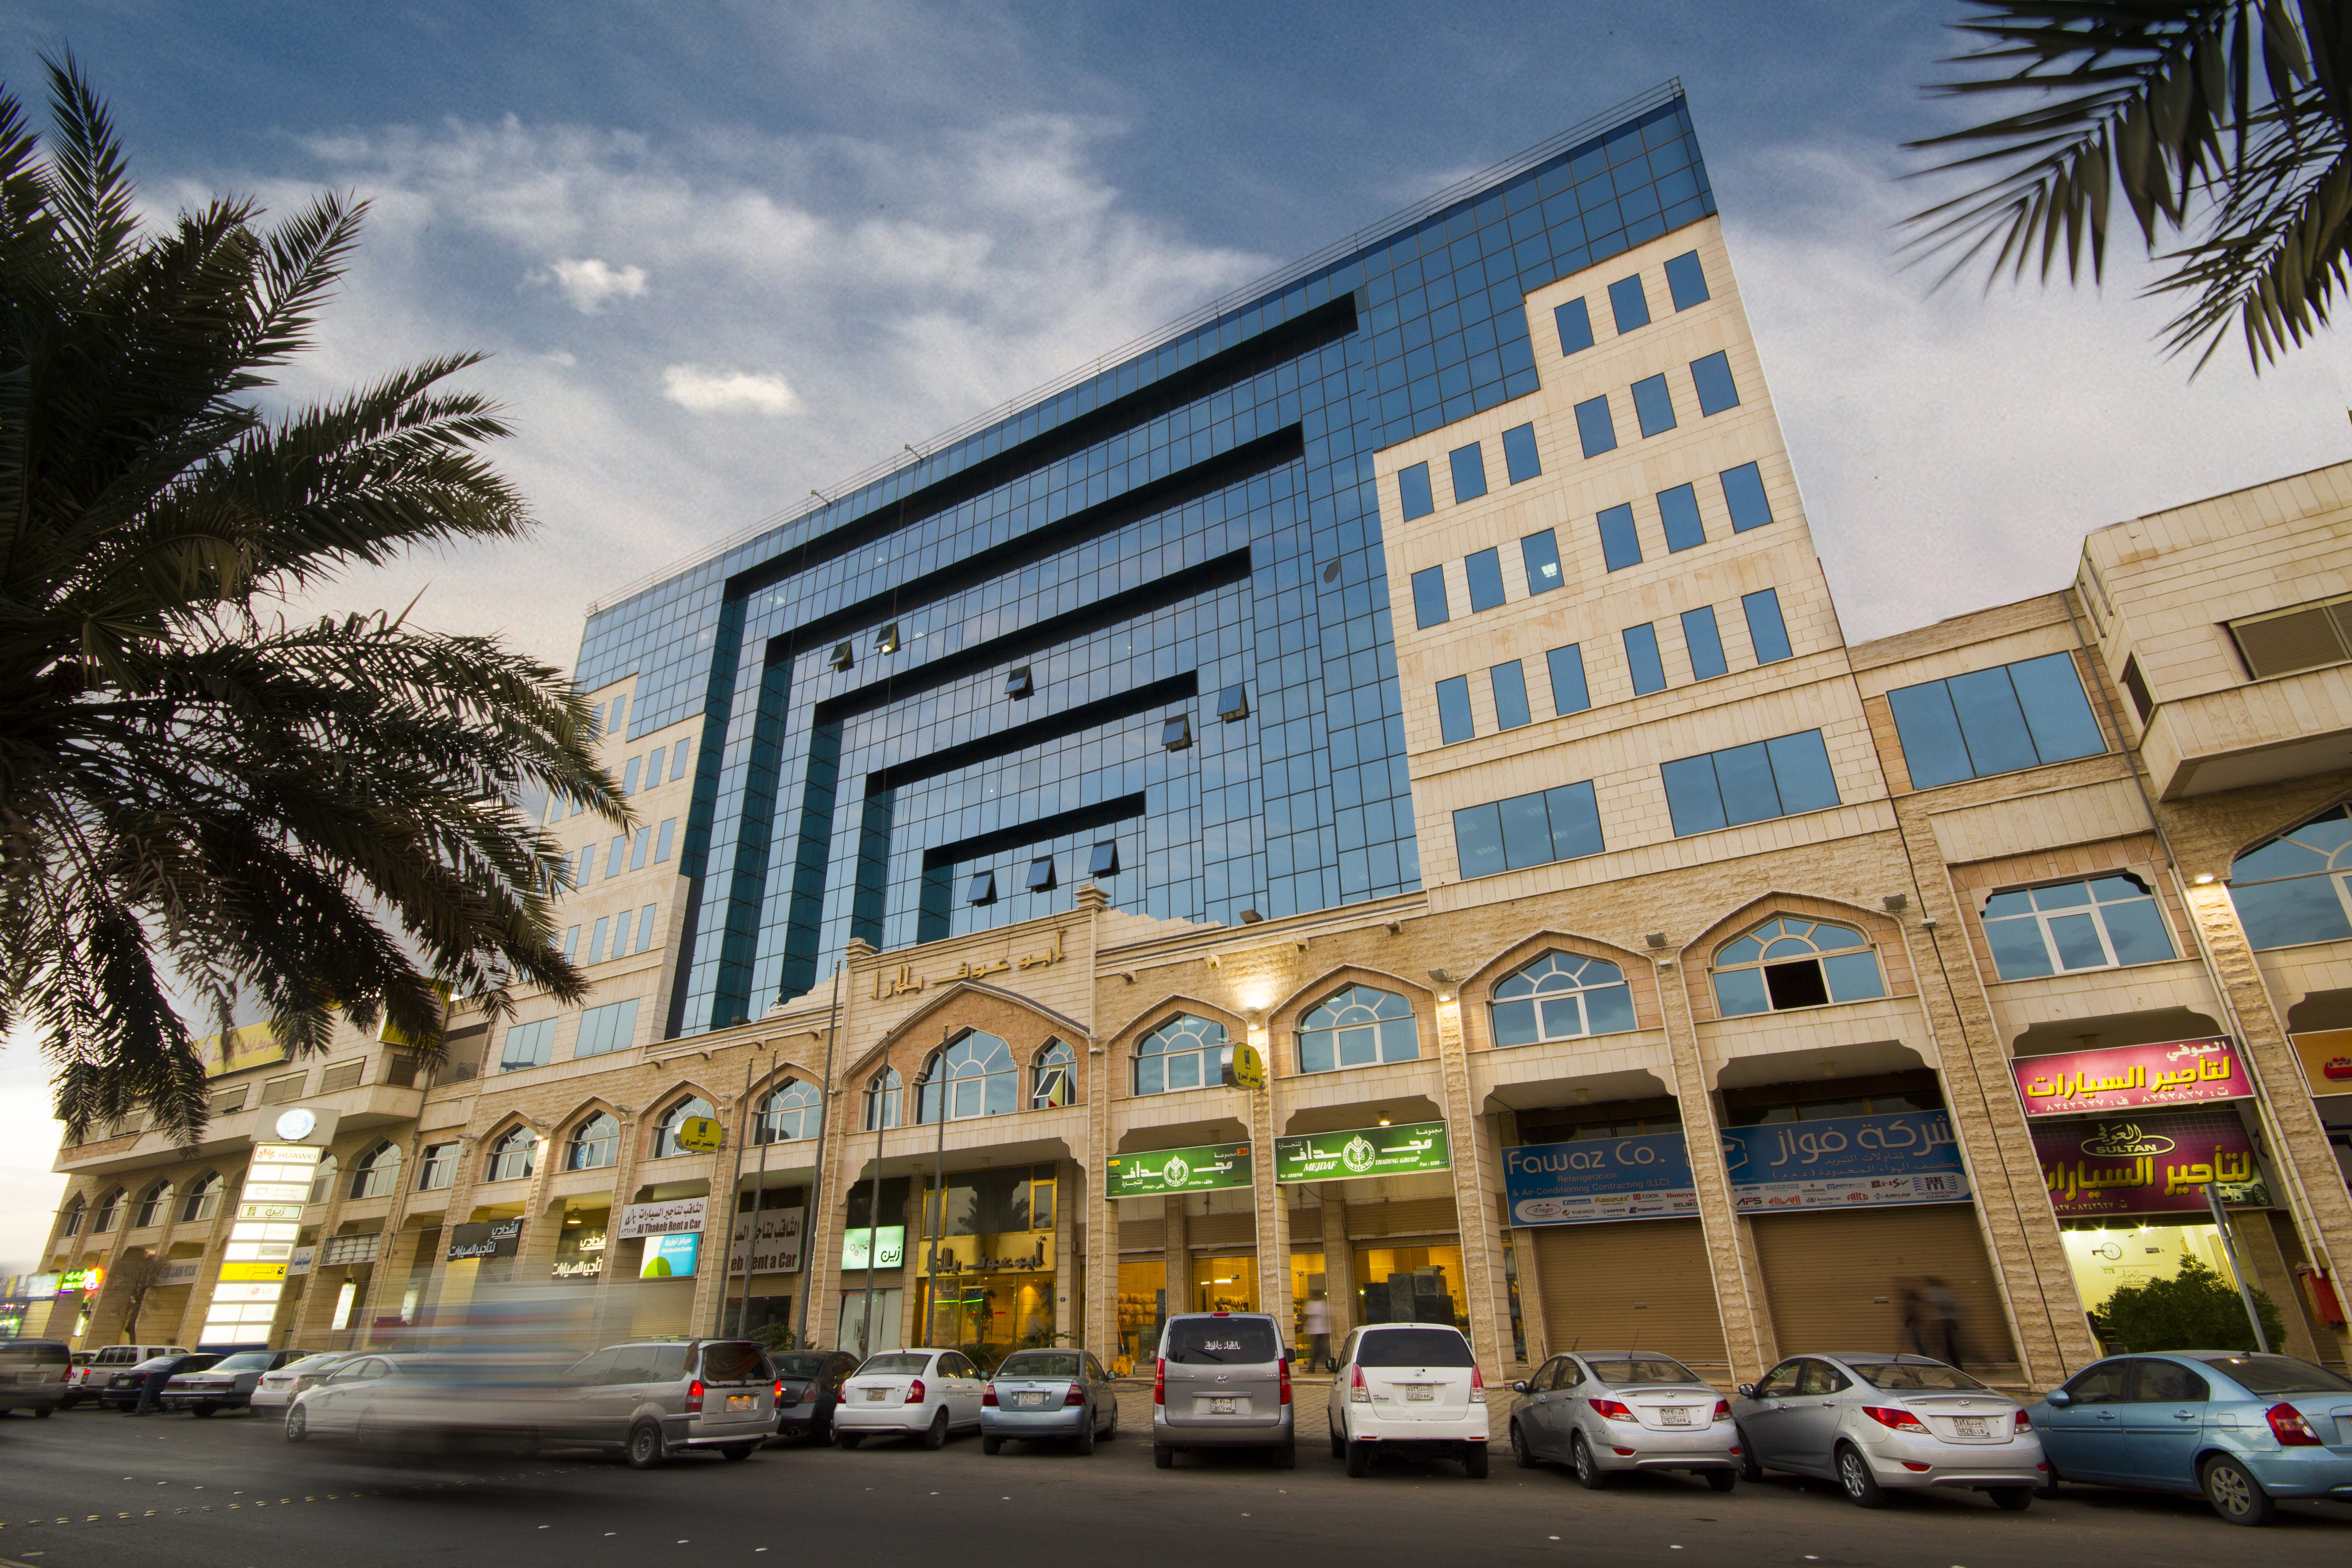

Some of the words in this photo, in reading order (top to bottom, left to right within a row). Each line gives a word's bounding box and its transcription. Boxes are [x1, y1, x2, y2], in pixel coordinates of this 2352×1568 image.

[1018, 926, 1066, 969] أبو
[868, 964, 924, 999] بلازا
[2166, 1040, 2227, 1061] العوفي
[2027, 1065, 2146, 1099] السيارات
[2150, 1055, 2231, 1093] لتأجير
[2142, 1089, 2204, 1103] ٨٣٩٢٨٢٧
[2046, 1098, 2104, 1112] ٨٣٤٢٦٢٧
[1857, 1115, 1958, 1156] شركة
[1278, 1141, 1302, 1150] للتجارة
[1615, 1140, 1666, 1166] Co.
[1770, 1127, 1848, 1166] فواز
[2096, 1143, 2157, 1153] SULTAN
[1303, 1161, 1338, 1172] MEJDAF
[1824, 1154, 1858, 1166] التبريد
[1880, 1162, 1910, 1174] الهواء
[1558, 1172, 1617, 1183] Referigeration
[1819, 1165, 1875, 1177] المحدودة
[2164, 1145, 2251, 1196] لتأجير
[1122, 1179, 1143, 1188] للتجارة
[1522, 1184, 1590, 1196] Air-Conditioning
[1592, 1180, 1643, 1192] Contracting
[1646, 1178, 1670, 1188] (LLC)
[1737, 1197, 1763, 1205] AFS
[1768, 1196, 1801, 1205] eliwell
[265, 1207, 286, 1216] زين
[639, 1207, 663, 1220] السيارات
[684, 1201, 703, 1217] الثاقب
[637, 1224, 644, 1234] Al
[645, 1221, 667, 1233] Thakeb
[668, 1220, 683, 1231] Rent
[684, 1221, 688, 1230] a
[690, 1219, 701, 1230] Car
[448, 1243, 477, 1259] السيارات
[881, 1246, 900, 1263] زين
[583, 1256, 603, 1276] تأجير
[770, 1255, 776, 1269] a
[779, 1252, 797, 1268] Car
[552, 1261, 584, 1277] السيارات
